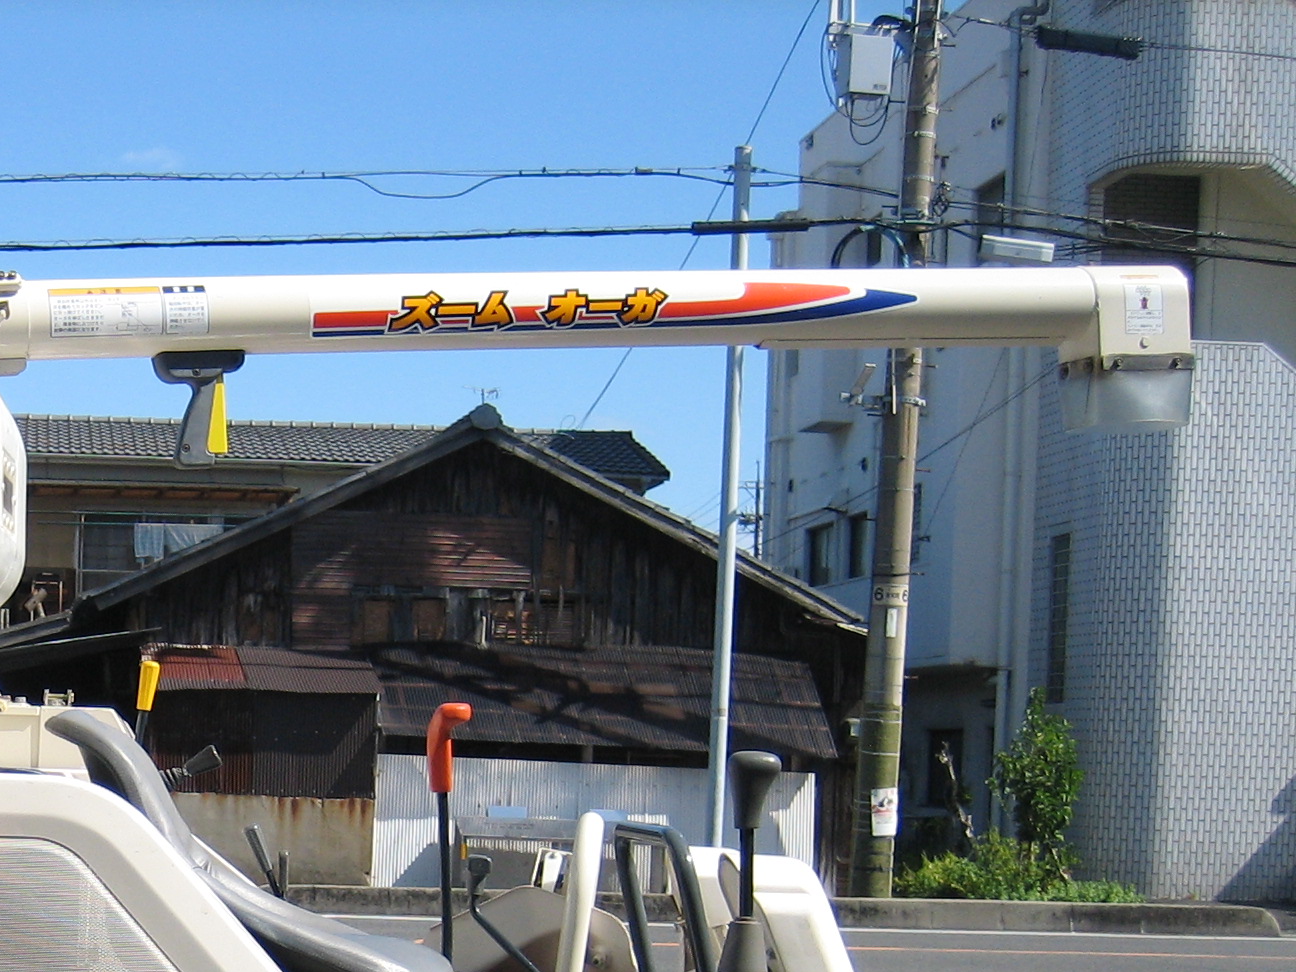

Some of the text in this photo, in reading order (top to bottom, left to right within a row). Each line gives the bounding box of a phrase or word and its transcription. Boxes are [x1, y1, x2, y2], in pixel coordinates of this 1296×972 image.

[388, 288, 667, 332] ズーム オーガ
